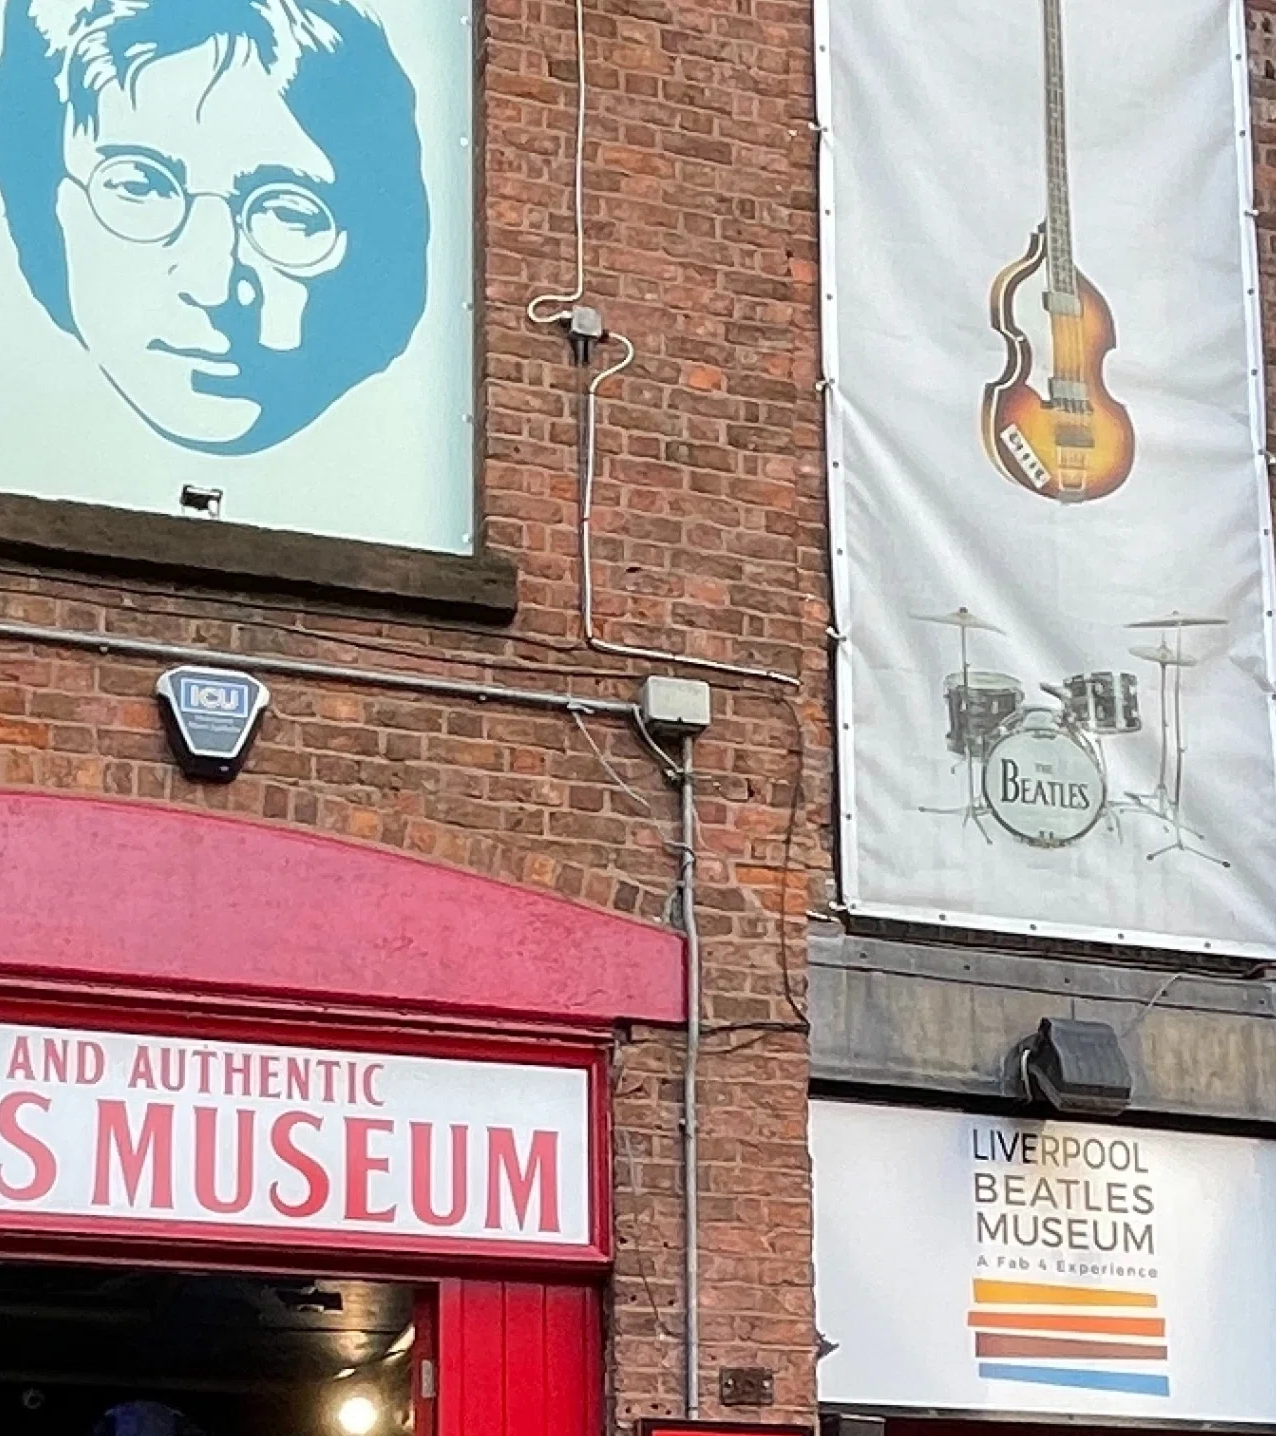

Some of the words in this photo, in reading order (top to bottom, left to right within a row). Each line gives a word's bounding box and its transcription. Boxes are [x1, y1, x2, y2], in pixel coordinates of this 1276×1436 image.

[190, 685, 239, 711] ICU
[1001, 758, 1090, 810] BEATLES
[6, 1038, 107, 1086] AND
[128, 1044, 387, 1107] AUTHENTIC
[91, 1098, 563, 1235] MUSEUM
[973, 1127, 1149, 1174] LIVERPOOL
[974, 1172, 1154, 1215] BEATLES
[976, 1211, 1155, 1255] MUSEUM
[976, 1256, 989, 1268] A
[997, 1256, 1030, 1271] Fab
[1038, 1258, 1048, 1271] 4
[1056, 1261, 1159, 1279] Experience
